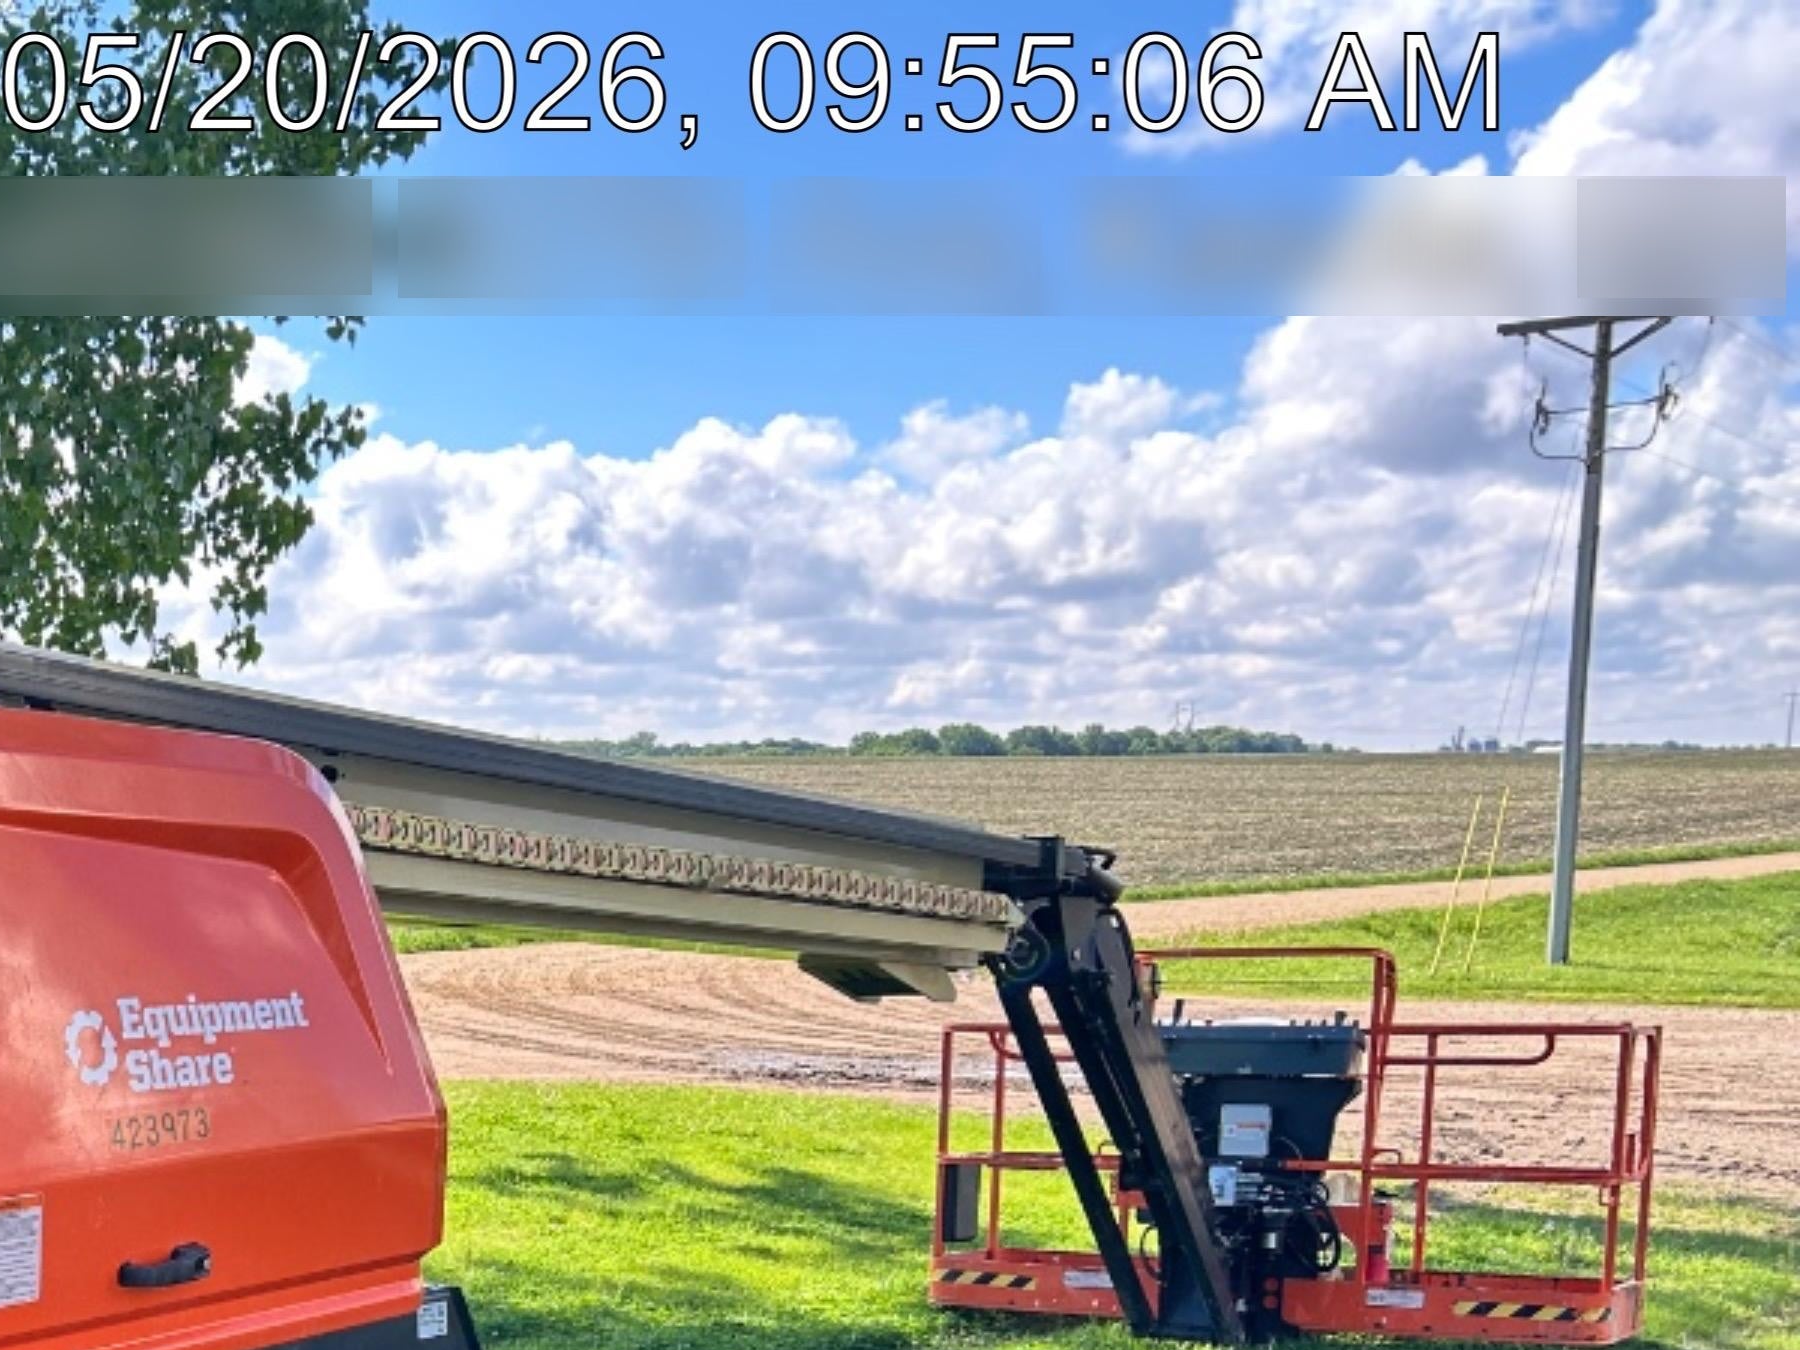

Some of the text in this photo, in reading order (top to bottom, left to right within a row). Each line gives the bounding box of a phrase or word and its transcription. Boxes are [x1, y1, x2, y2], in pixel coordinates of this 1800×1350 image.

[116, 989, 310, 1048] Equipment
[125, 1049, 235, 1093] Share
[111, 1106, 211, 1150] 423973
